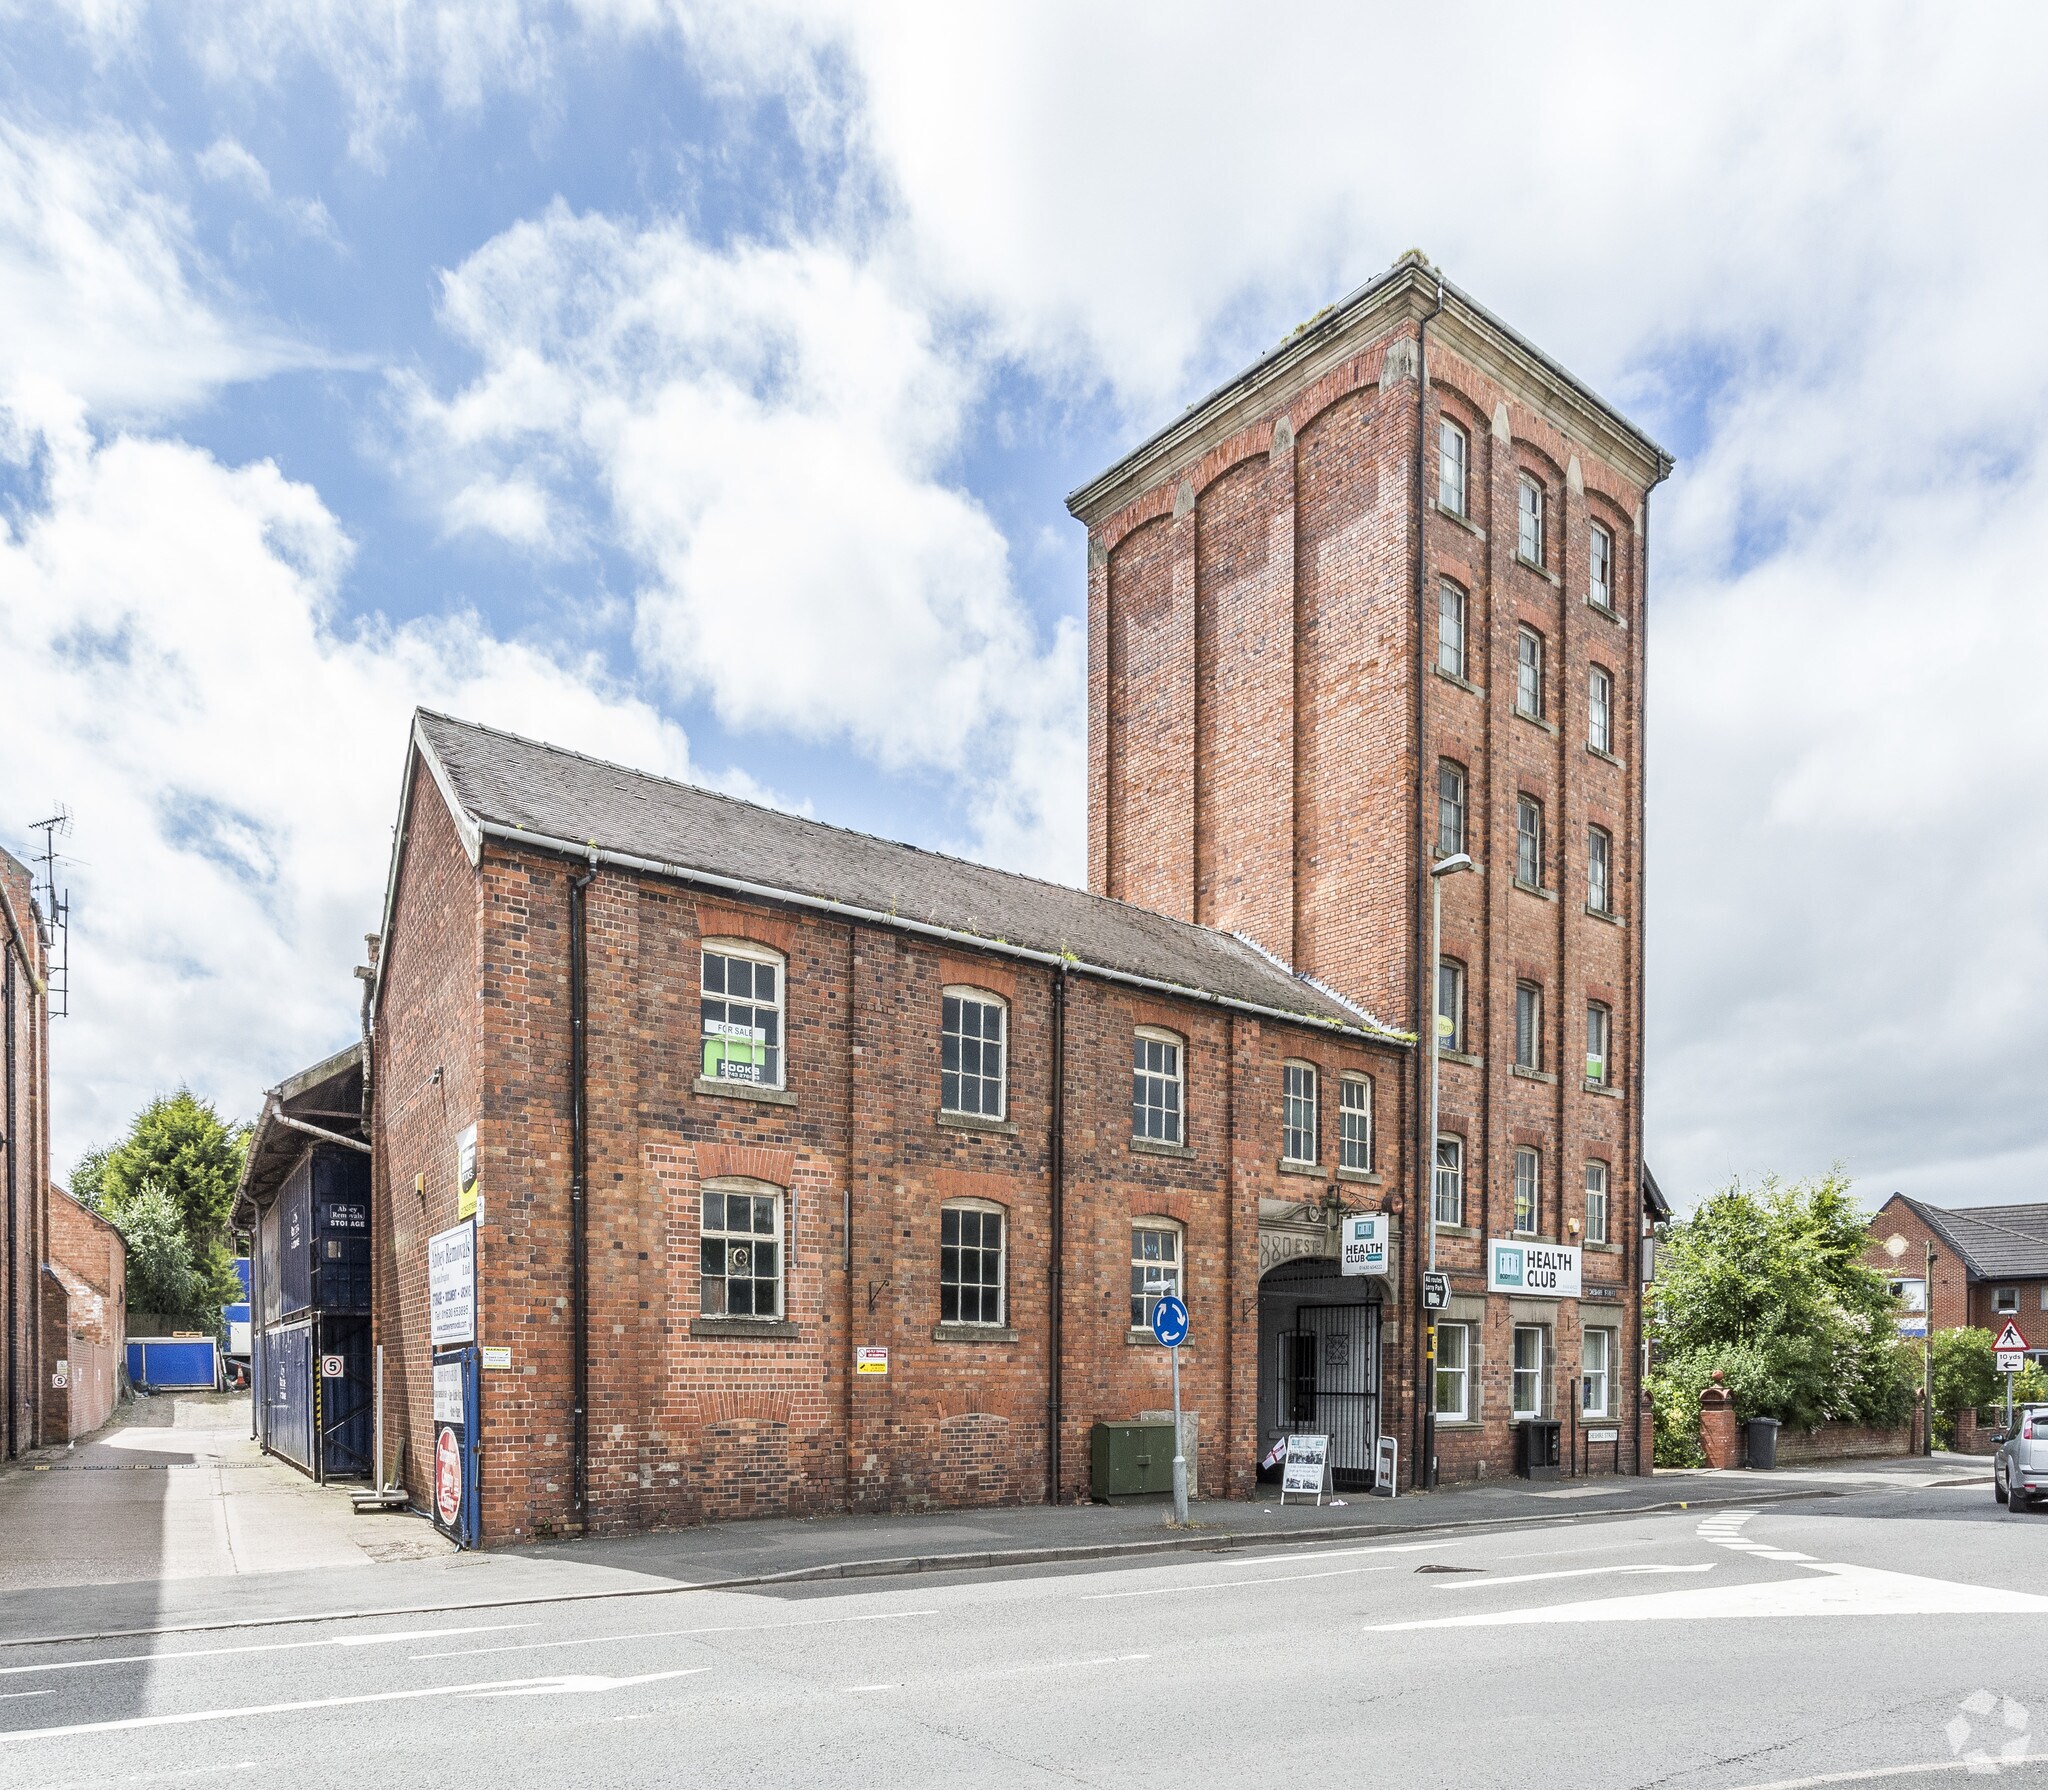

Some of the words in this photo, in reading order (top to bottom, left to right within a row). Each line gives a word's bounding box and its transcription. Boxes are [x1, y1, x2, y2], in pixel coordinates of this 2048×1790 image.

[717, 1024, 733, 1034] FOR
[735, 1027, 752, 1037] SALE
[337, 1205, 358, 1213] Abey
[1346, 1243, 1382, 1255] HEALTH
[1346, 1254, 1366, 1263] CLUB
[1527, 1250, 1572, 1271] HEALTH
[1527, 1270, 1557, 1288] CLUB
[329, 1361, 337, 1371] 5
